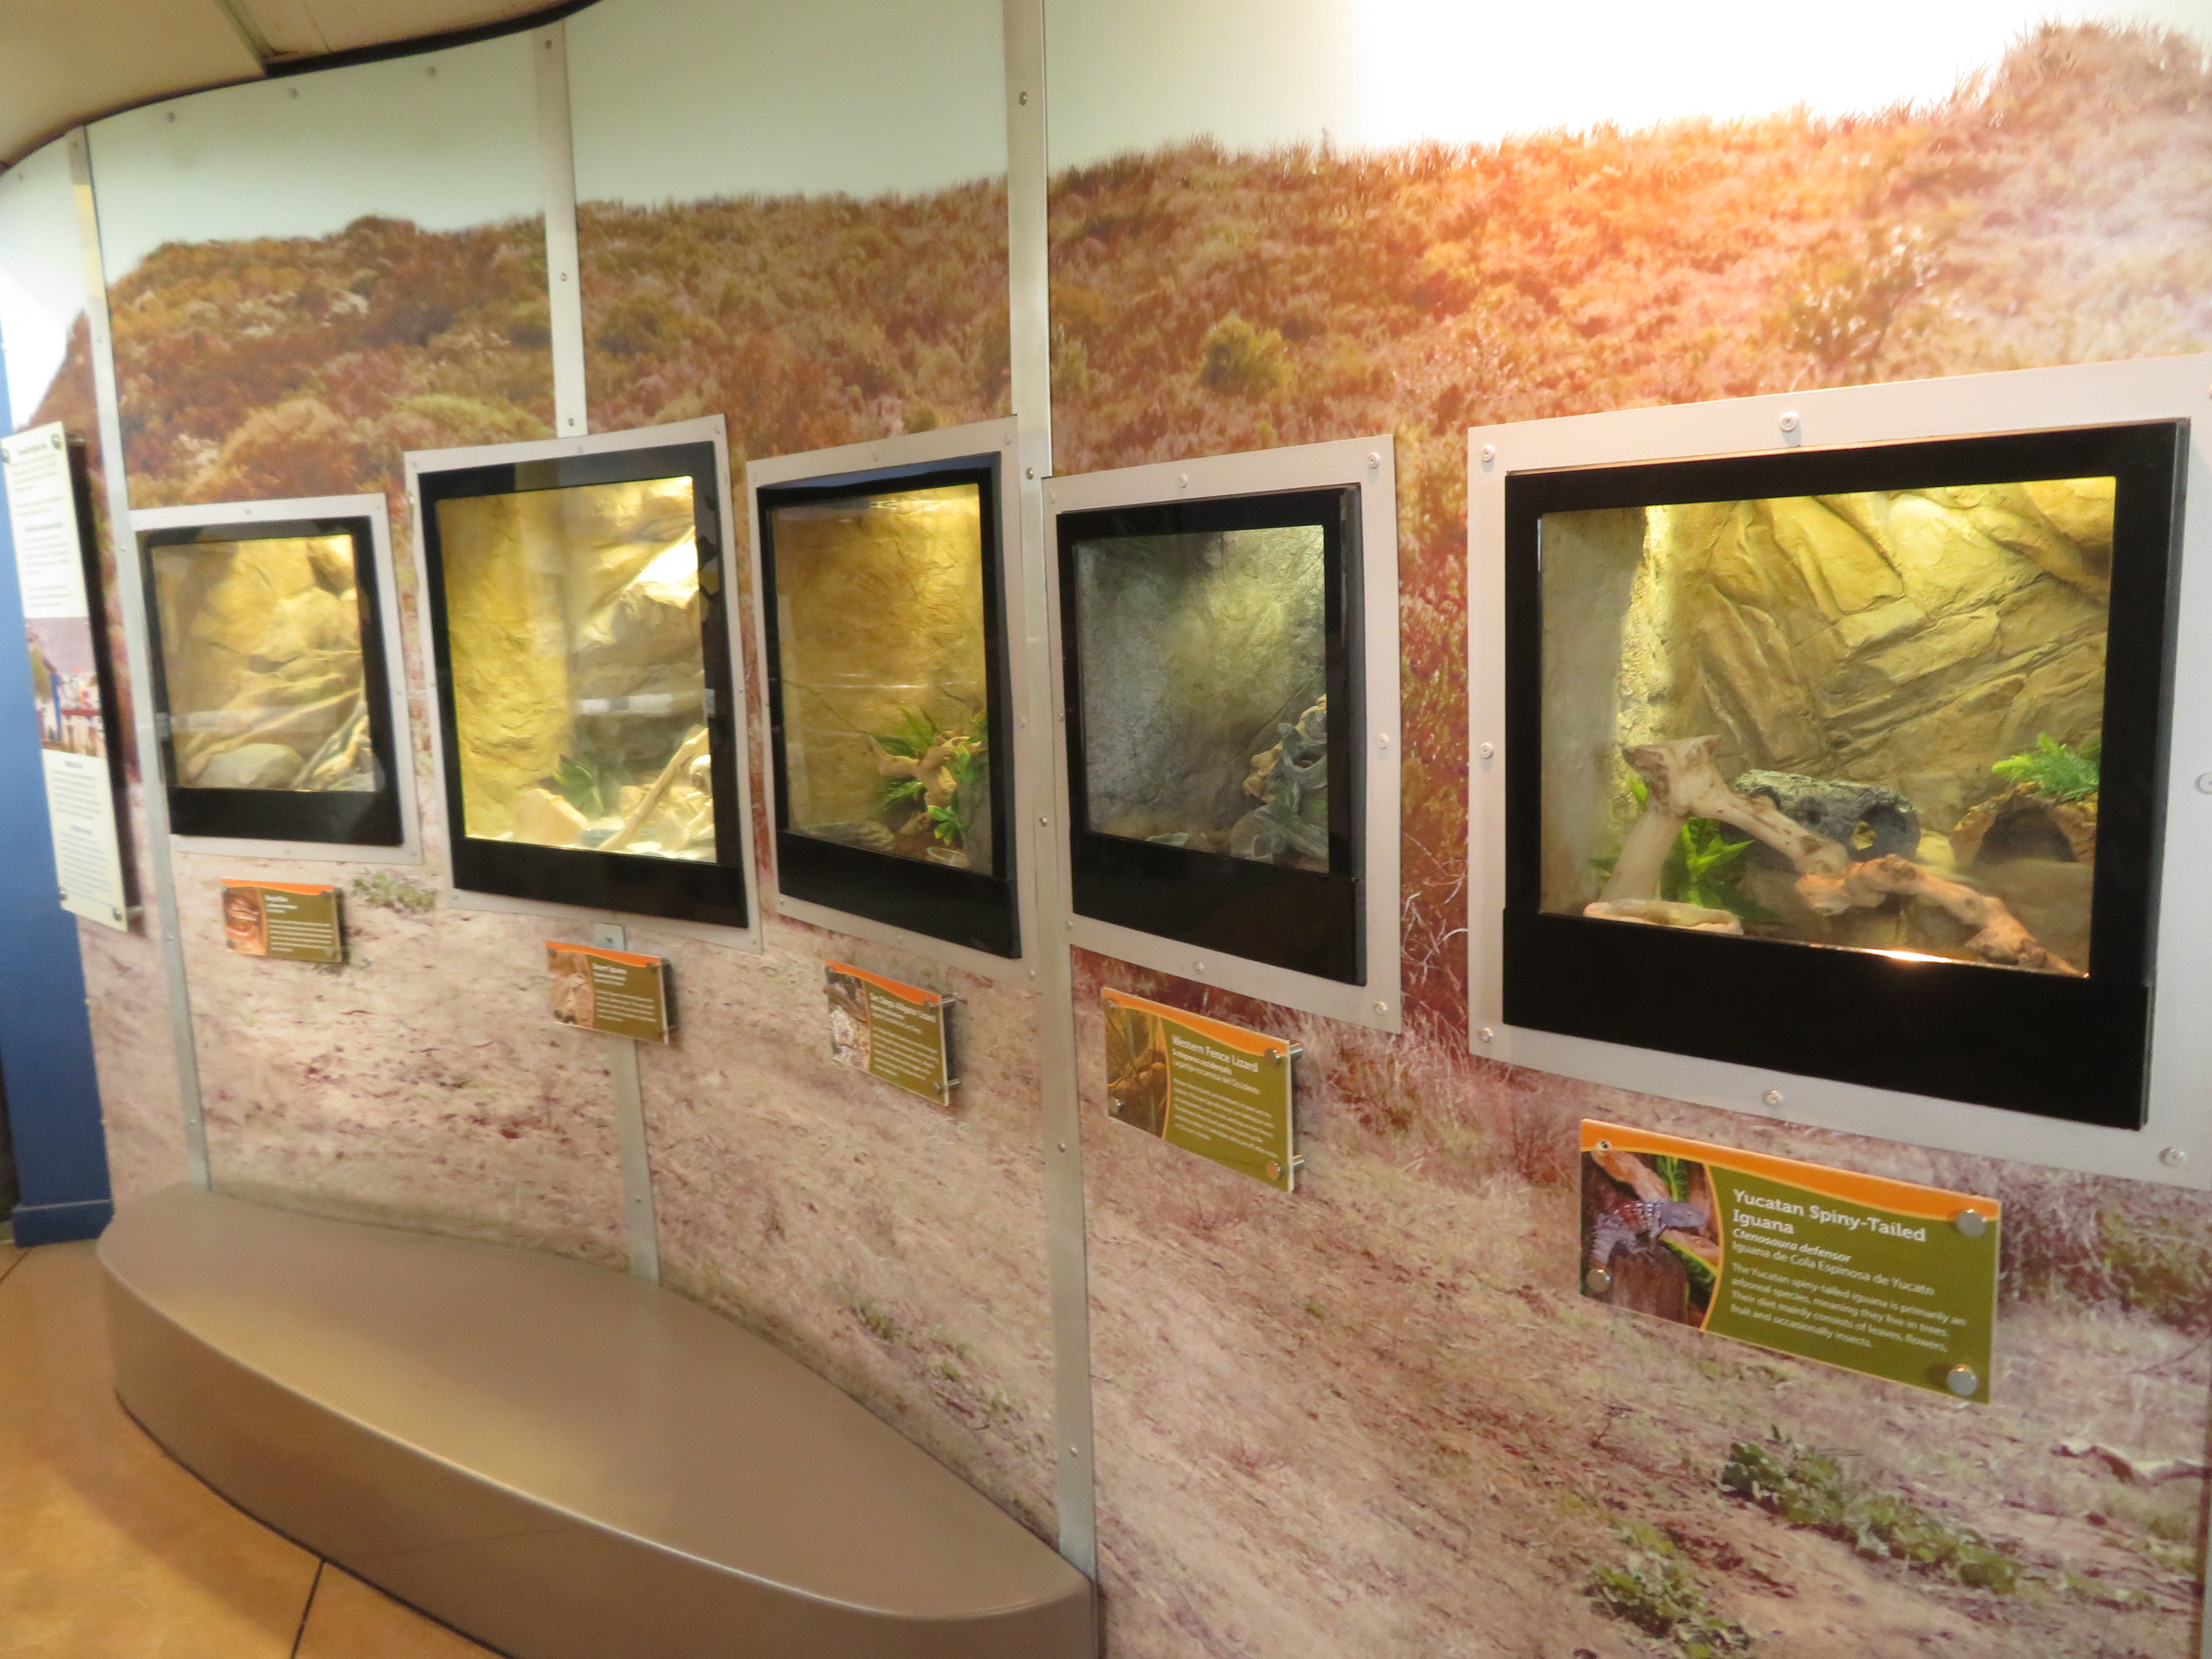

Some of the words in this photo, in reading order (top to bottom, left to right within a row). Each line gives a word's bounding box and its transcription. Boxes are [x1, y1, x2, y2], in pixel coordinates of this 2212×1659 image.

[1172, 1035, 1204, 1055] Western
[1206, 1046, 1230, 1062] Fence
[1232, 1055, 1258, 1072] Lizard
[1733, 1188, 1804, 1216] Yucatan
[1809, 1204, 1926, 1242] Spiny-Tailed
[1733, 1209, 1795, 1234] Iguana
[1732, 1228, 1798, 1250] Ctenosaura
[1799, 1243, 1852, 1262] defensor
[1772, 1250, 1789, 1262] de
[1790, 1253, 1816, 1269] Cola
[1872, 1273, 1889, 1286] de
